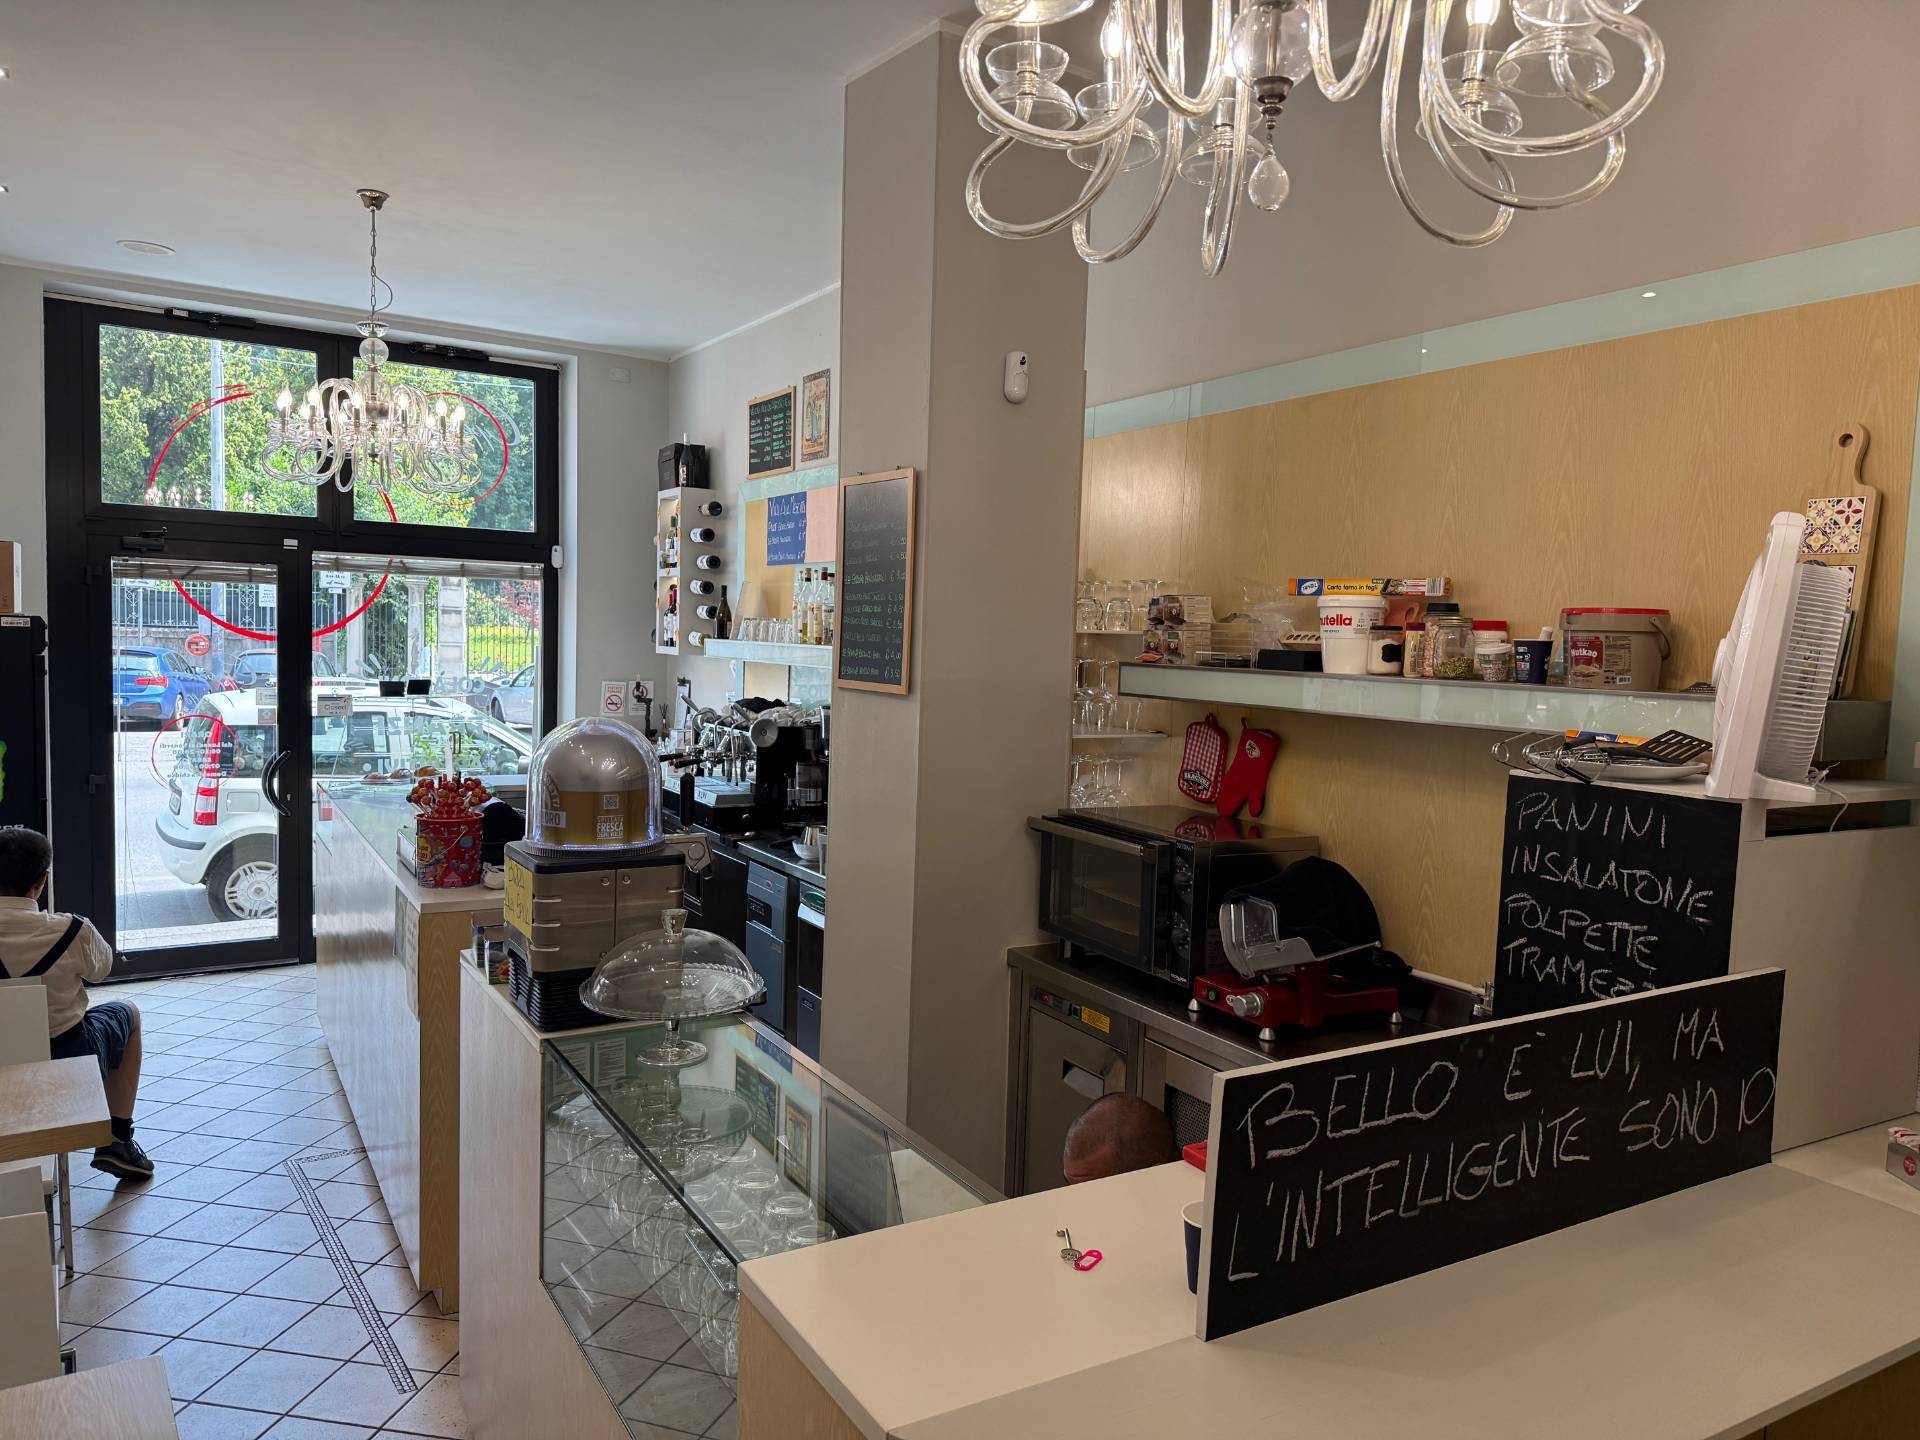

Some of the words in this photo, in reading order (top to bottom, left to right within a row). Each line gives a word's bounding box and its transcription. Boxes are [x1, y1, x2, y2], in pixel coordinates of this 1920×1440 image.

[1319, 613, 1352, 627] utella
[597, 822, 624, 832] FRESCA
[1517, 791, 1667, 848] PANINI
[1510, 843, 1714, 925] INSALATONE
[1504, 892, 1659, 970] POLPETTE
[1236, 1060, 1459, 1168] BELLO
[1672, 1007, 1725, 1061] MA
[1227, 1106, 1591, 1283] L'INTELLIGENTE
[1618, 1079, 1719, 1153] SONO
[1737, 1066, 1776, 1133] IO
